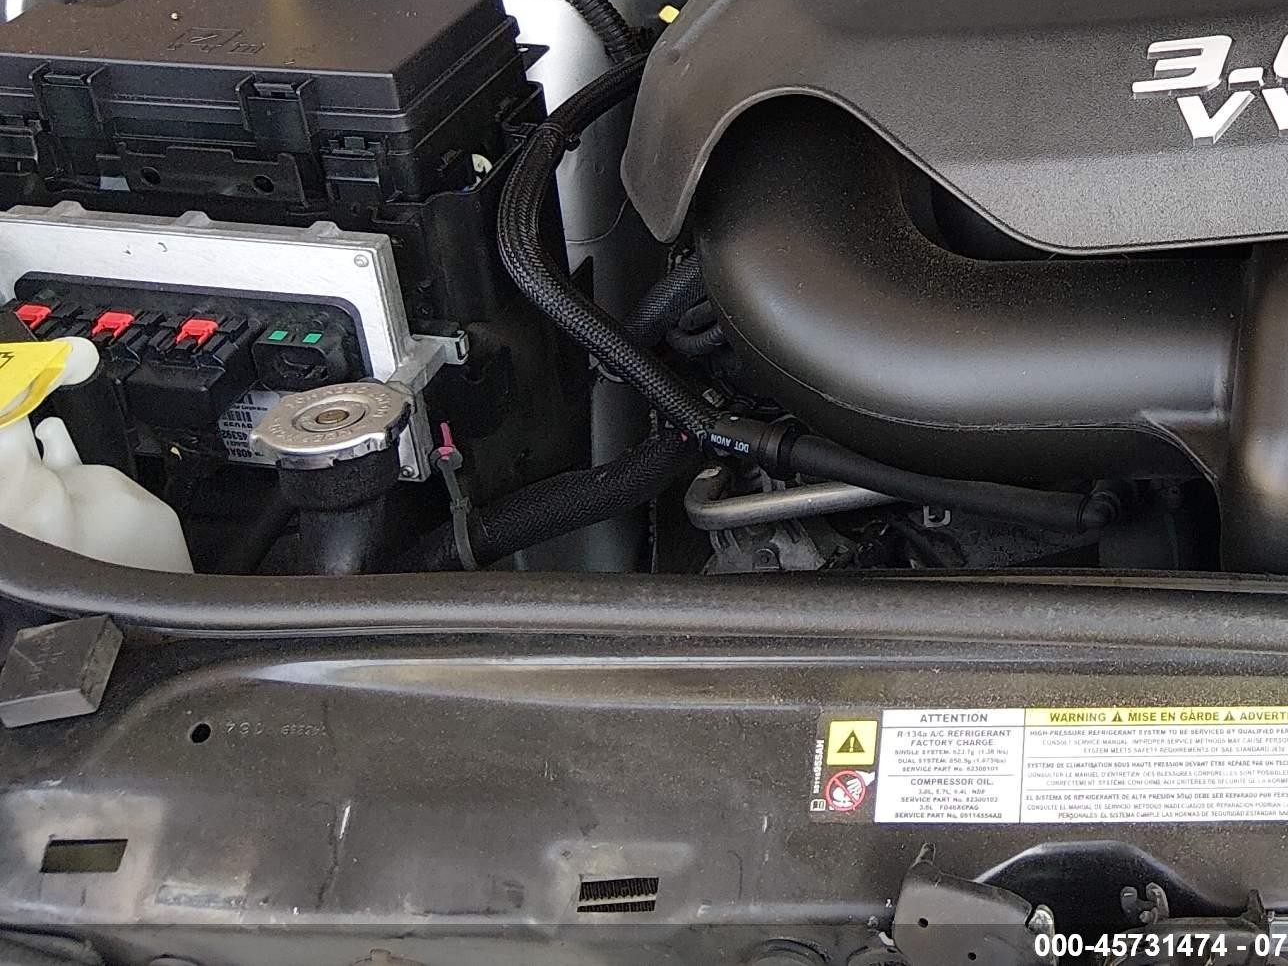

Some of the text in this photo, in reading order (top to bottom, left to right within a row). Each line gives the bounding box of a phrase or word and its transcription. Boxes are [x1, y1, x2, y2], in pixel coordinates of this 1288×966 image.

[710, 434, 750, 453] DOT AVON
[919, 713, 988, 722] ATTENTION
[1049, 712, 1106, 722] WARNING
[1127, 712, 1157, 721] MISE
[1160, 711, 1176, 721] EN
